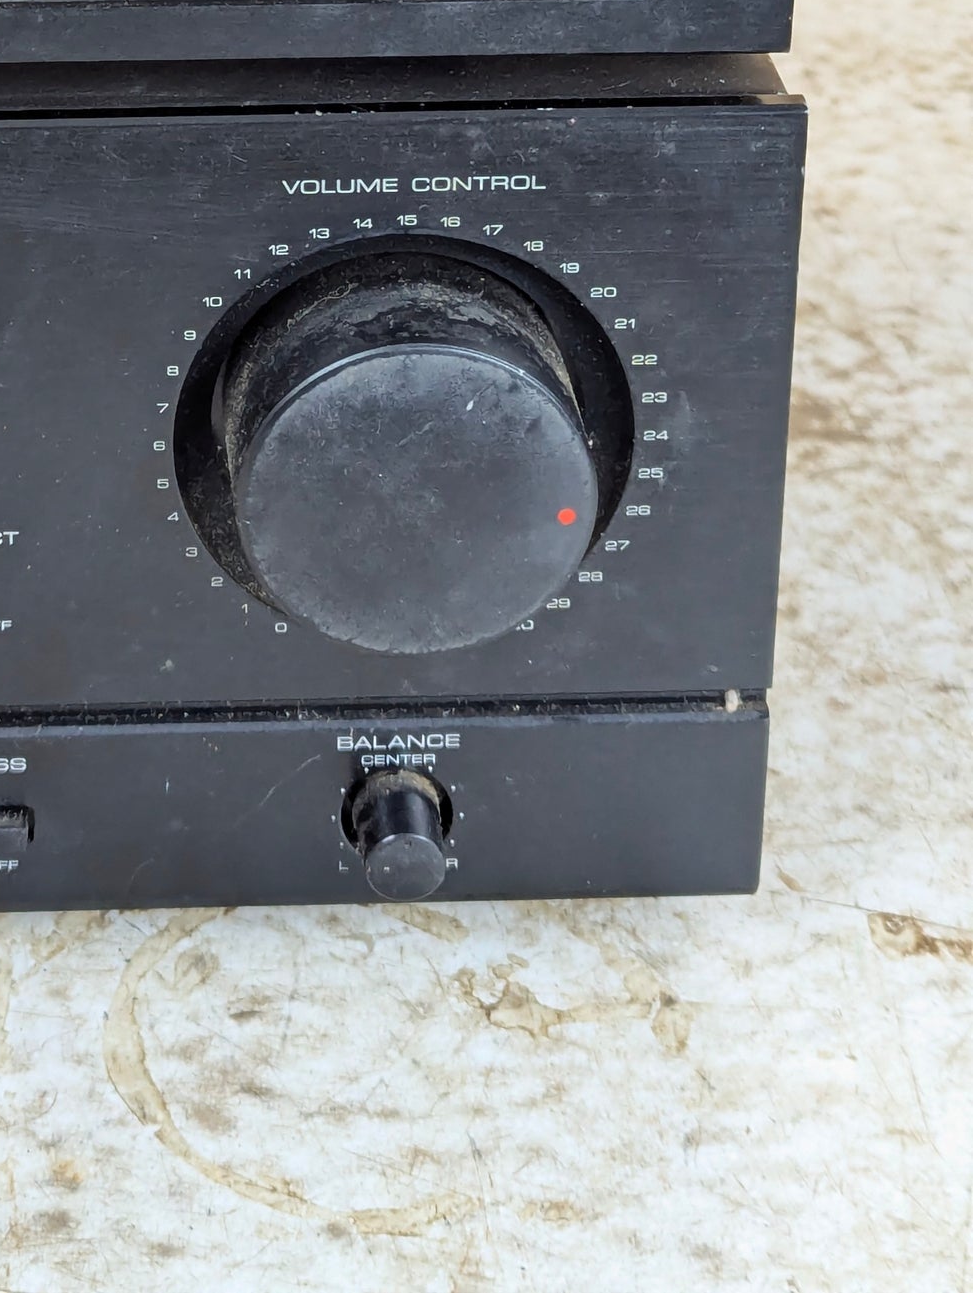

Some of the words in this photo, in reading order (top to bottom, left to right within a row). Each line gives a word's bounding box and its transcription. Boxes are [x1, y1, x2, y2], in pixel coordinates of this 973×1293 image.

[282, 179, 398, 194] VOLUME
[412, 176, 546, 191] CONTROL
[352, 218, 373, 229] 14
[396, 214, 418, 226] 15
[440, 216, 461, 228] 16
[309, 227, 330, 239] 13
[482, 224, 504, 236] 17
[268, 244, 289, 256] 12
[523, 240, 544, 252] 18
[234, 268, 251, 280] 11
[559, 262, 580, 274] 19
[590, 286, 617, 298] 20
[202, 296, 223, 308] 10
[614, 318, 636, 329] 21
[183, 330, 197, 341] 9
[631, 354, 658, 366] 22
[166, 365, 179, 376] 8
[641, 391, 668, 403] 23
[156, 402, 169, 414] 7
[643, 430, 669, 441] 24
[153, 440, 166, 451] 6
[638, 467, 664, 479] 25
[156, 478, 170, 489] 5
[625, 504, 651, 516] 26
[167, 511, 179, 522] 4
[604, 539, 631, 552] 27
[185, 546, 198, 558] 3
[210, 576, 224, 587] 2
[578, 571, 603, 583] 28
[241, 603, 248, 614] 1
[546, 597, 571, 609] 29
[274, 622, 288, 633] 0
[516, 619, 535, 631] 0
[337, 734, 460, 750] BALANCE
[361, 754, 435, 766] CENTER
[445, 857, 459, 869] R
